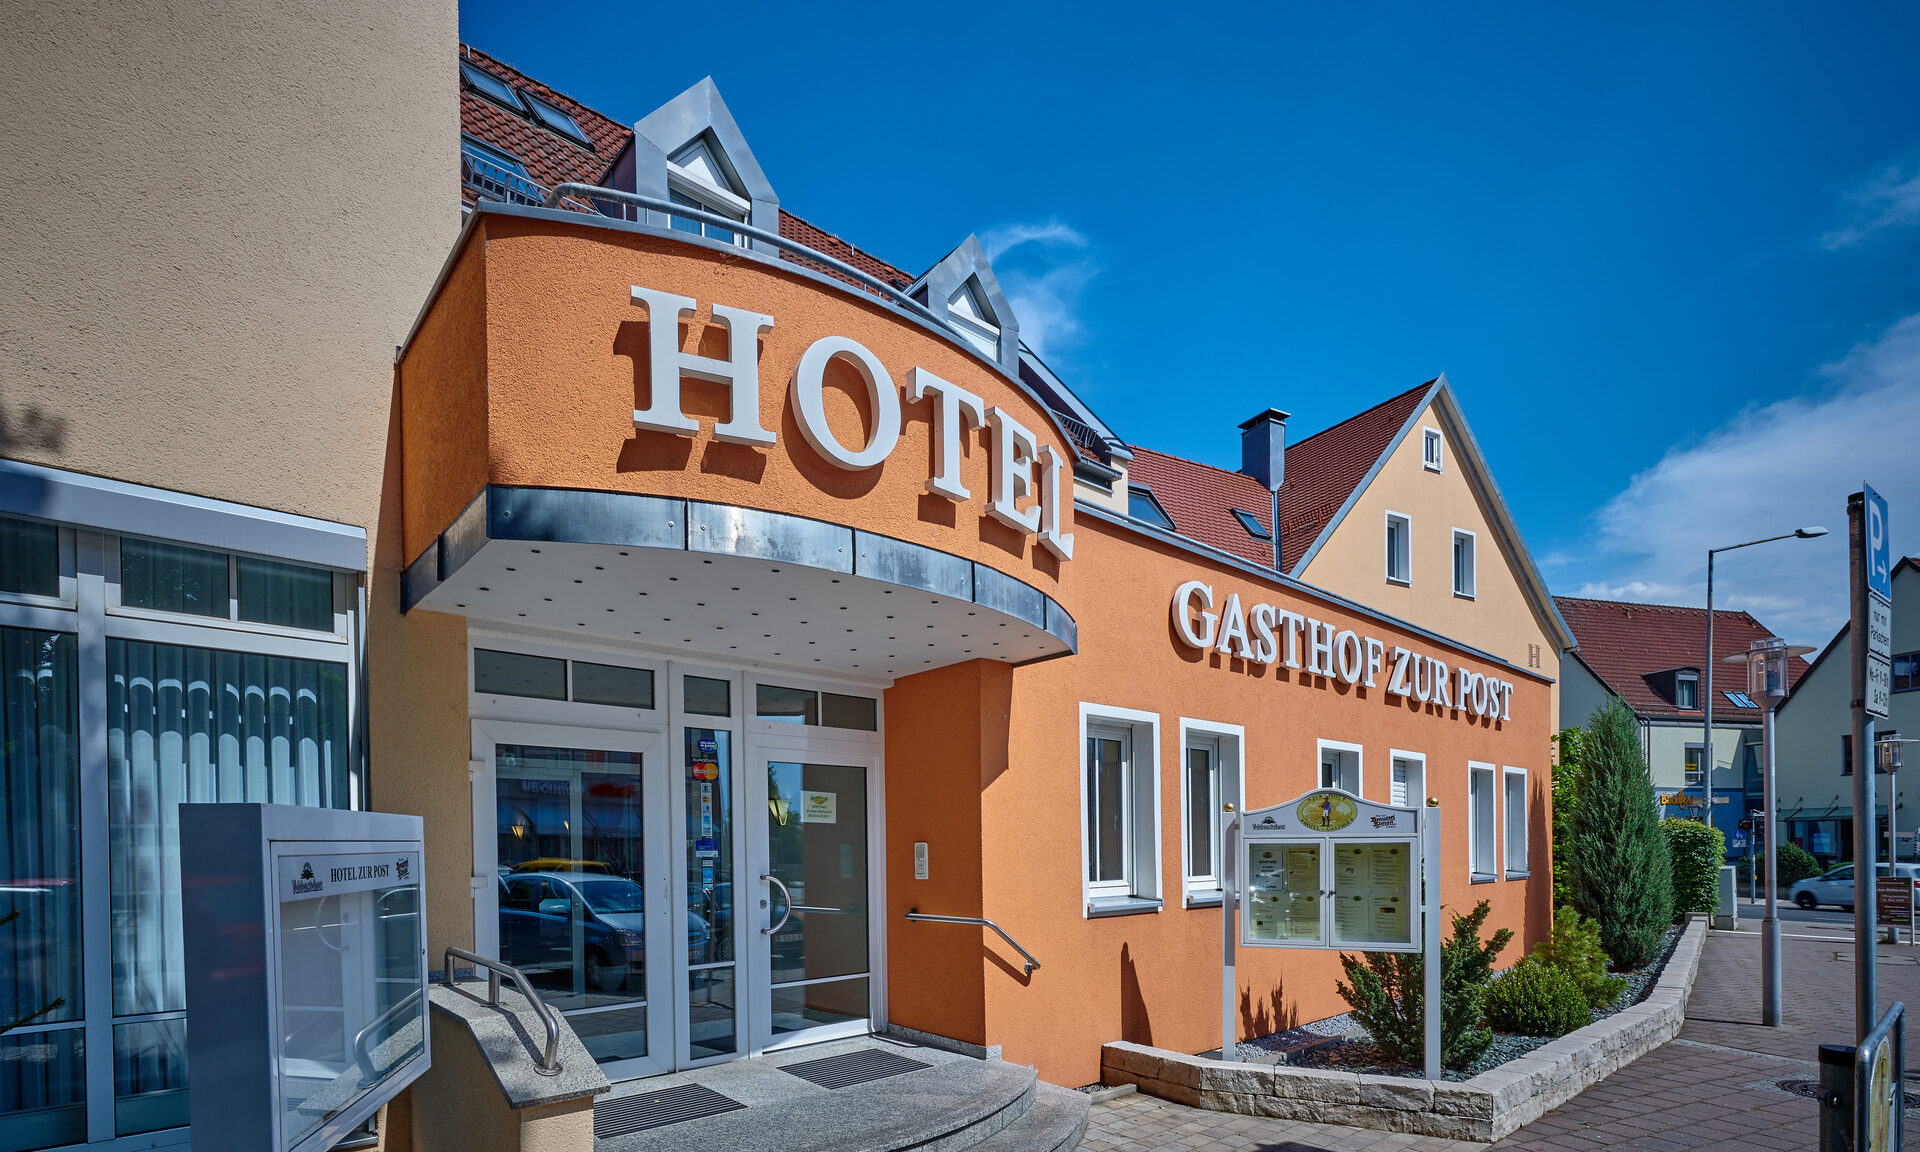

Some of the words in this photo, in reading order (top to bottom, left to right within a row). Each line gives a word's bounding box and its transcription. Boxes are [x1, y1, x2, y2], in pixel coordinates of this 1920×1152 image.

[631, 285, 1074, 562] HOTEL
[1869, 499, 1884, 576] P
[1172, 580, 1384, 688] GASTHOF
[1387, 646, 1452, 708] ZUR
[1454, 667, 1514, 722] POST
[331, 867, 357, 883] HOTEL
[359, 866, 373, 879] ZUR
[374, 864, 390, 878] POST
